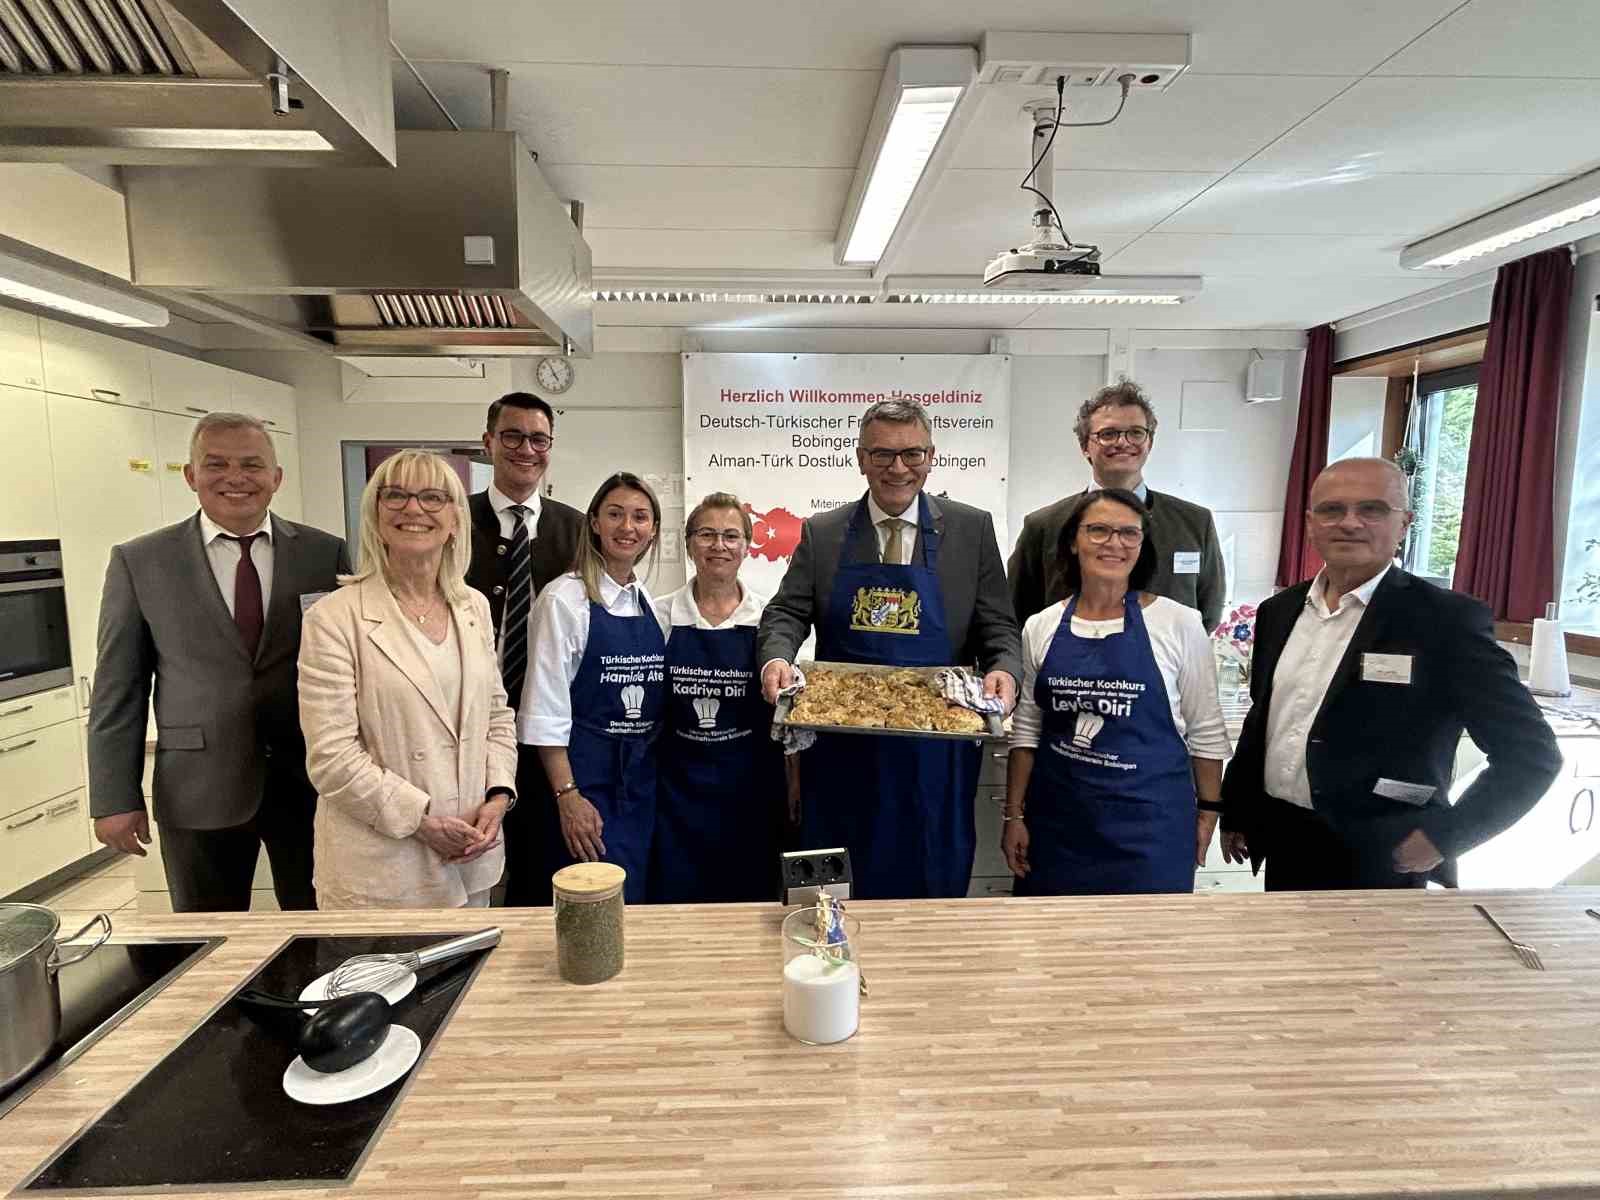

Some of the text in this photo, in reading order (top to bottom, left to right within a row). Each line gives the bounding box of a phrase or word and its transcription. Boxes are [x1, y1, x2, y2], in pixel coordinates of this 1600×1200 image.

[720, 388, 784, 403] Herzlich
[789, 389, 885, 404] Willkommen
[699, 414, 843, 429] Deutsch-Türkischer
[708, 453, 986, 471] Alman-Türk Dostluk obingen
[600, 670, 645, 684] Hamide
[669, 665, 713, 677] Türkischer
[672, 682, 746, 698] Kadriye Diri
[1047, 676, 1146, 692] Türkischer Kochkurs
[1097, 698, 1132, 717] Diri
